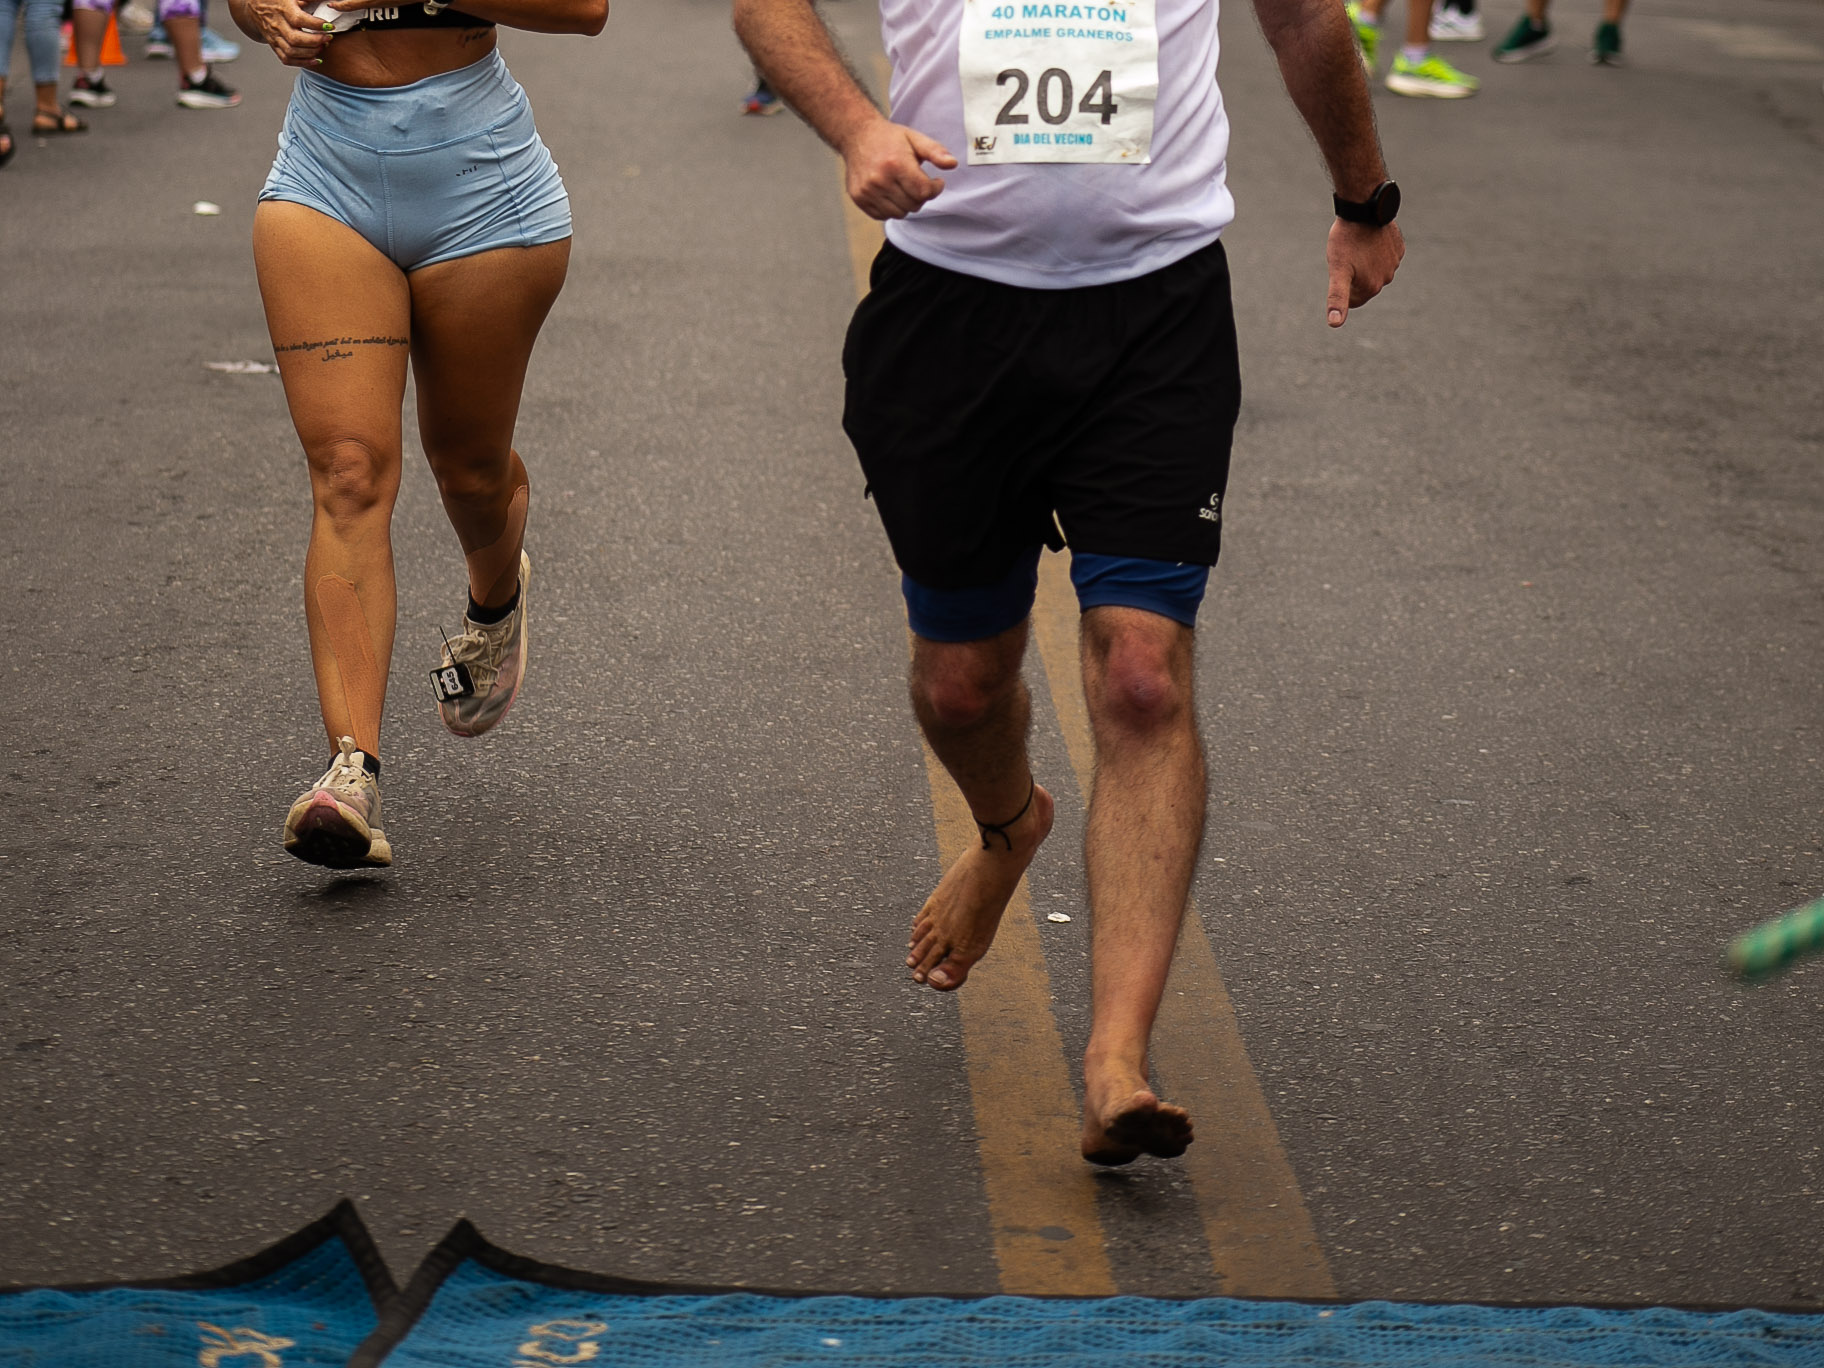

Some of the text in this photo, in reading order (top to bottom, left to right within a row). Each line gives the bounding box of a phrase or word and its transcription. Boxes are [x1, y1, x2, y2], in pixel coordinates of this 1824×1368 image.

[991, 4, 1126, 23] 40 MARATON
[985, 28, 1134, 42] EMPALME GRANEROS
[995, 67, 1118, 126] 204
[1013, 133, 1093, 145] DIA DEL VECINO
[447, 671, 459, 691] 645
